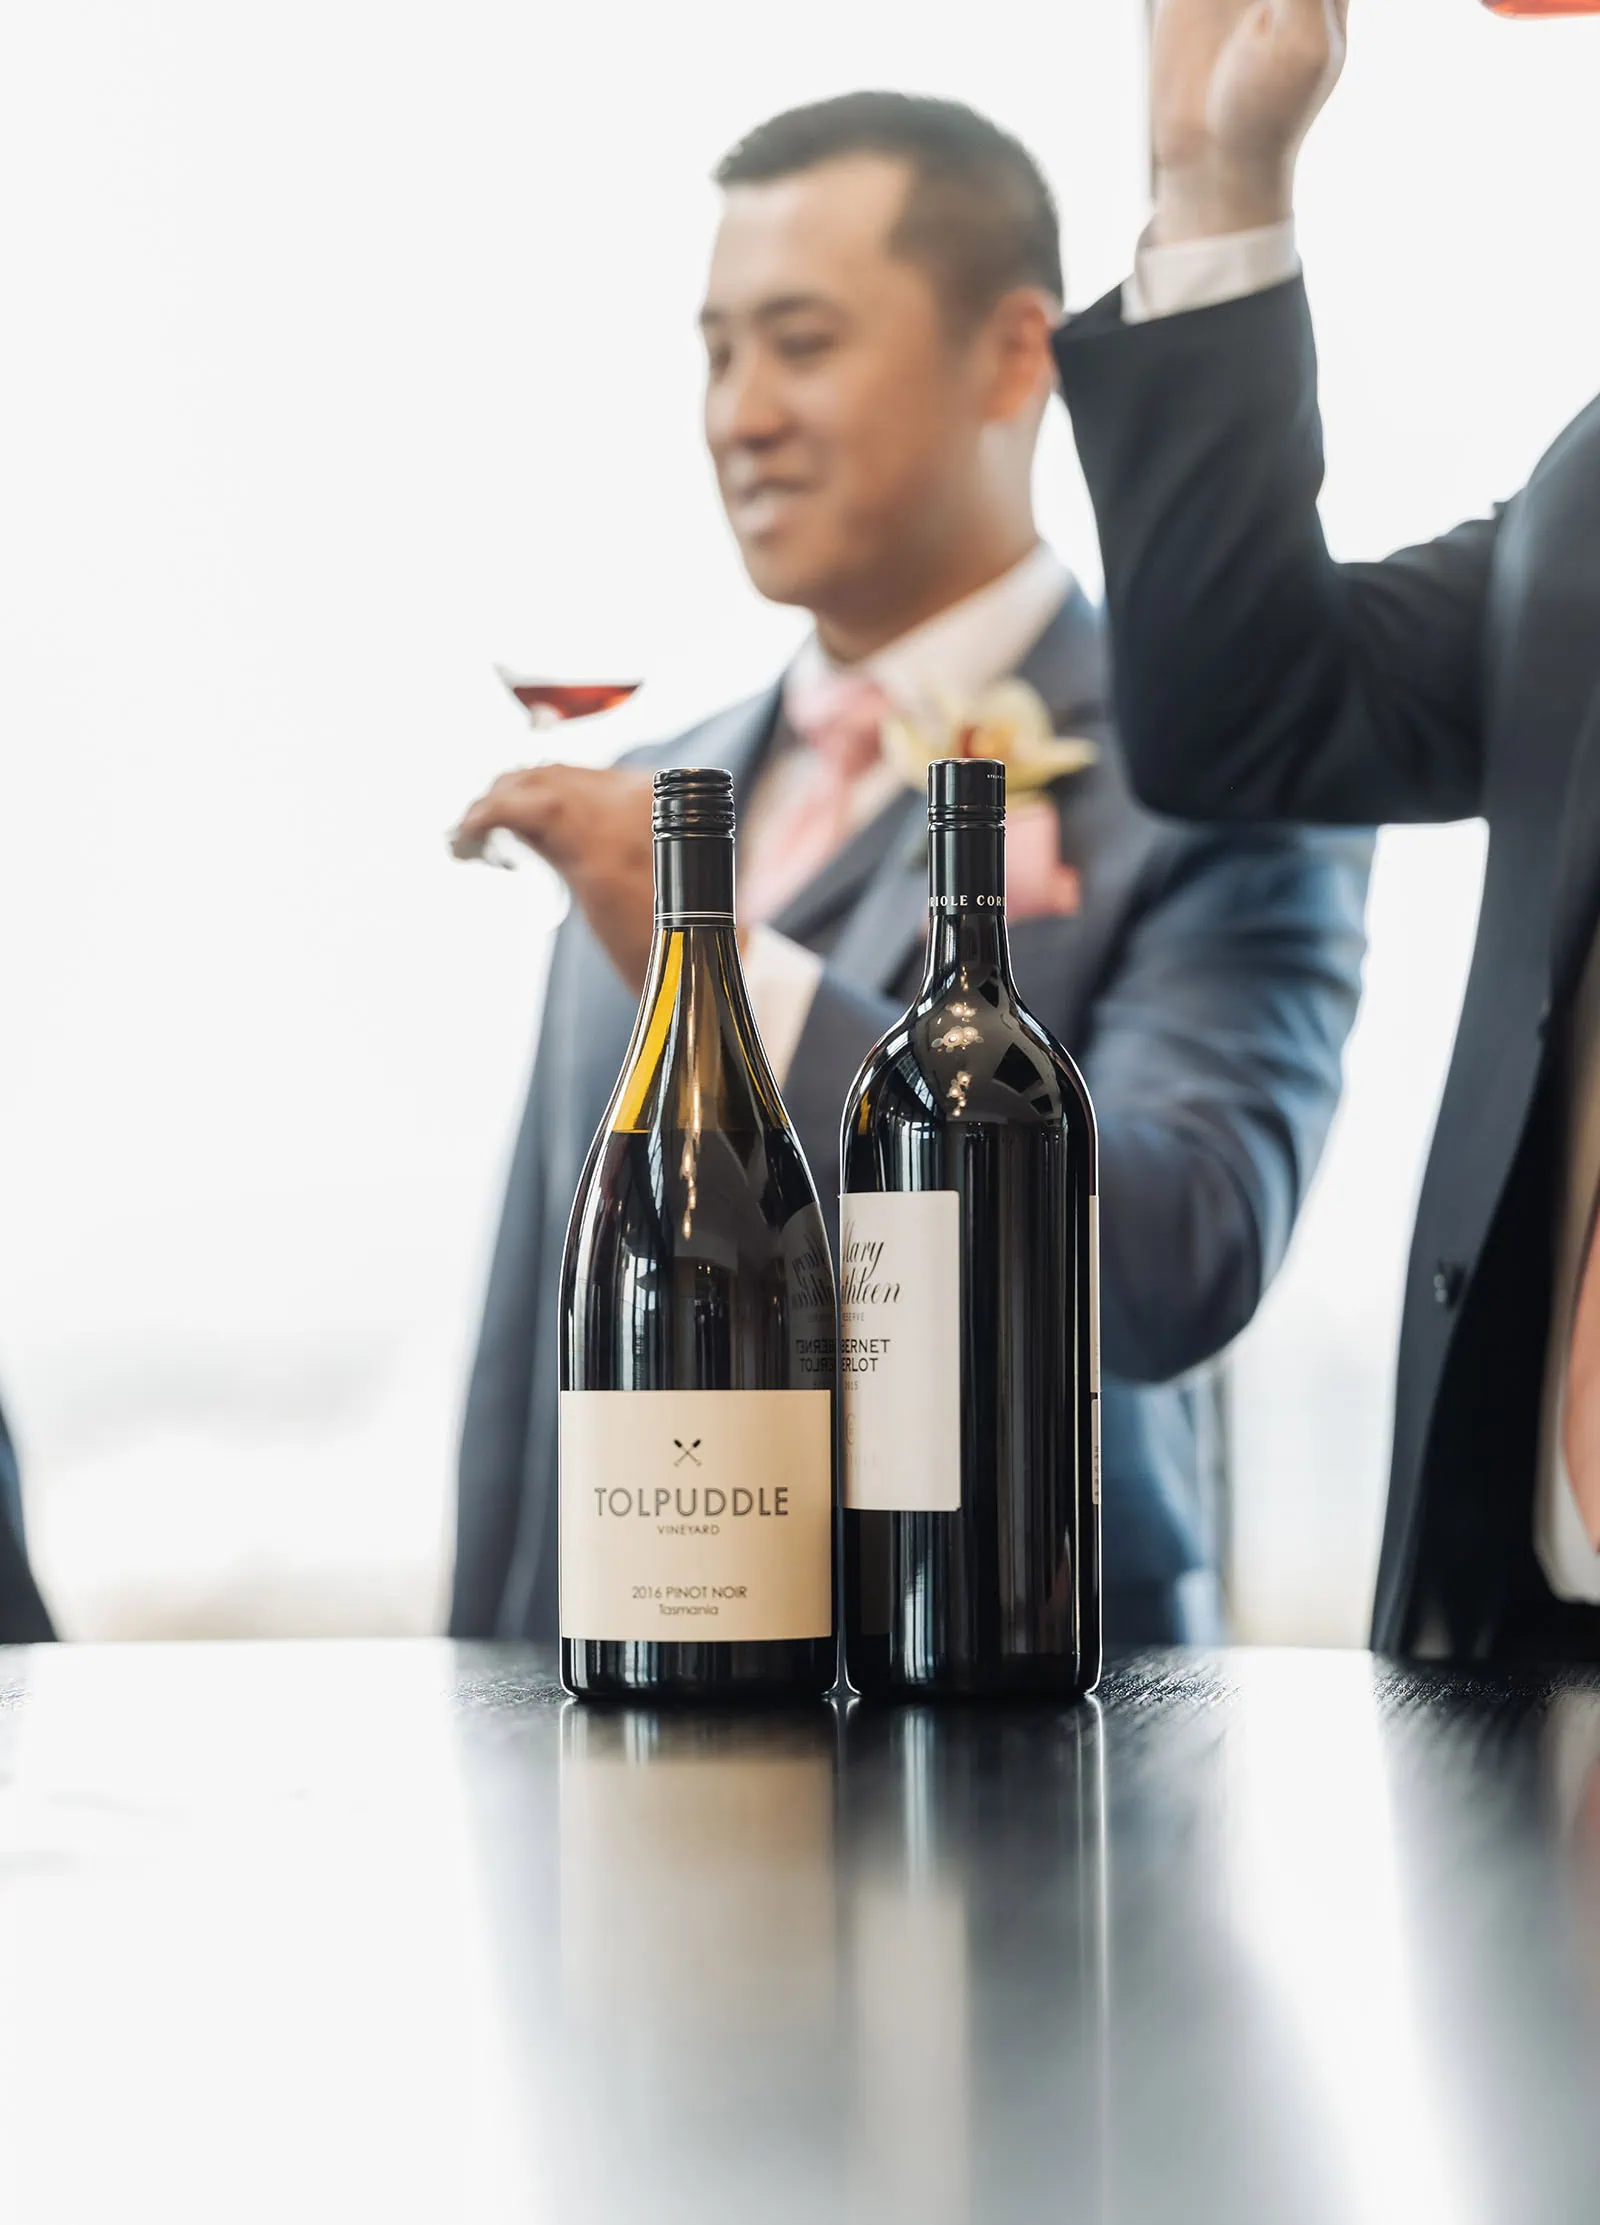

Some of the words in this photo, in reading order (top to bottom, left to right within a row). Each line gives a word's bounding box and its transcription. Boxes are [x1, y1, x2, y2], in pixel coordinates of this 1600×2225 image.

[928, 894, 969, 907] RIOLE
[841, 1357, 879, 1373] ERLOT
[594, 1487, 789, 1518] TOLPUDDLE
[657, 1524, 721, 1536] VINEYARD
[631, 1585, 664, 1600] 2016
[666, 1585, 708, 1599] PINOT
[711, 1585, 748, 1599] NOIR
[659, 1603, 720, 1616] Tasmania
